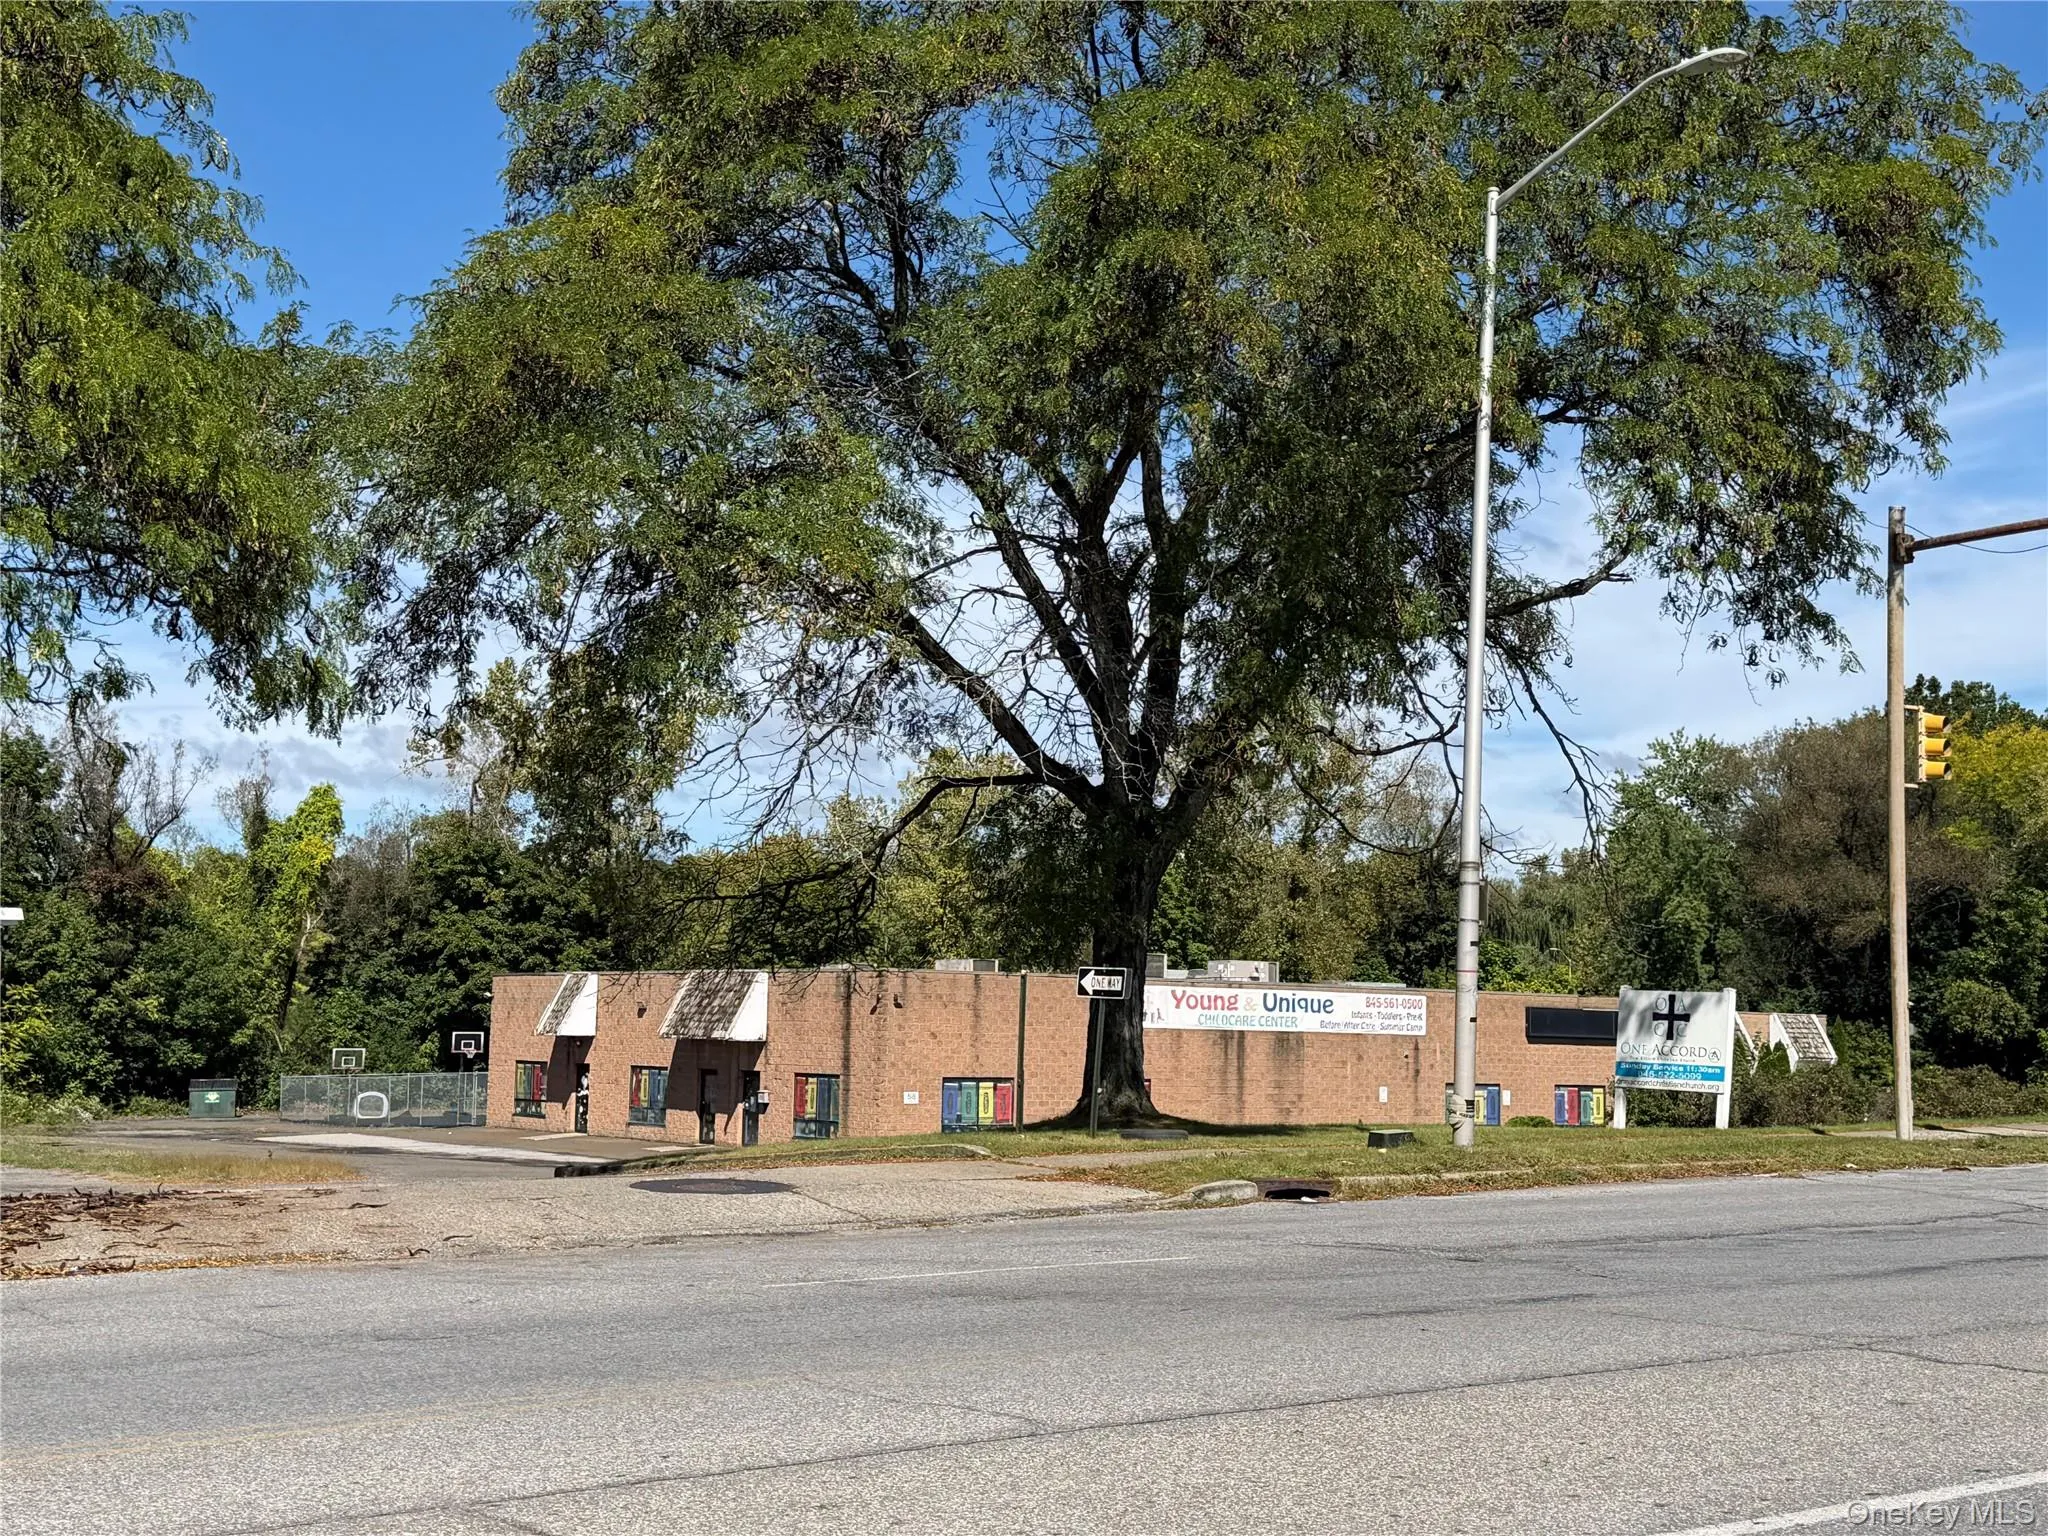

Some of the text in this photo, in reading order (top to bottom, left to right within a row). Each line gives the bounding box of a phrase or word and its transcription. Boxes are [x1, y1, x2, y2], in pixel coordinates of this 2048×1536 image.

[1091, 976, 1106, 988] ONE
[1171, 989, 1335, 1014] Young & Unique
[1365, 996, 1423, 1010] 845-561-0500
[1197, 1013, 1299, 1029] CHILDCARE CENTER
[1652, 1043, 1707, 1058] ACCORD
